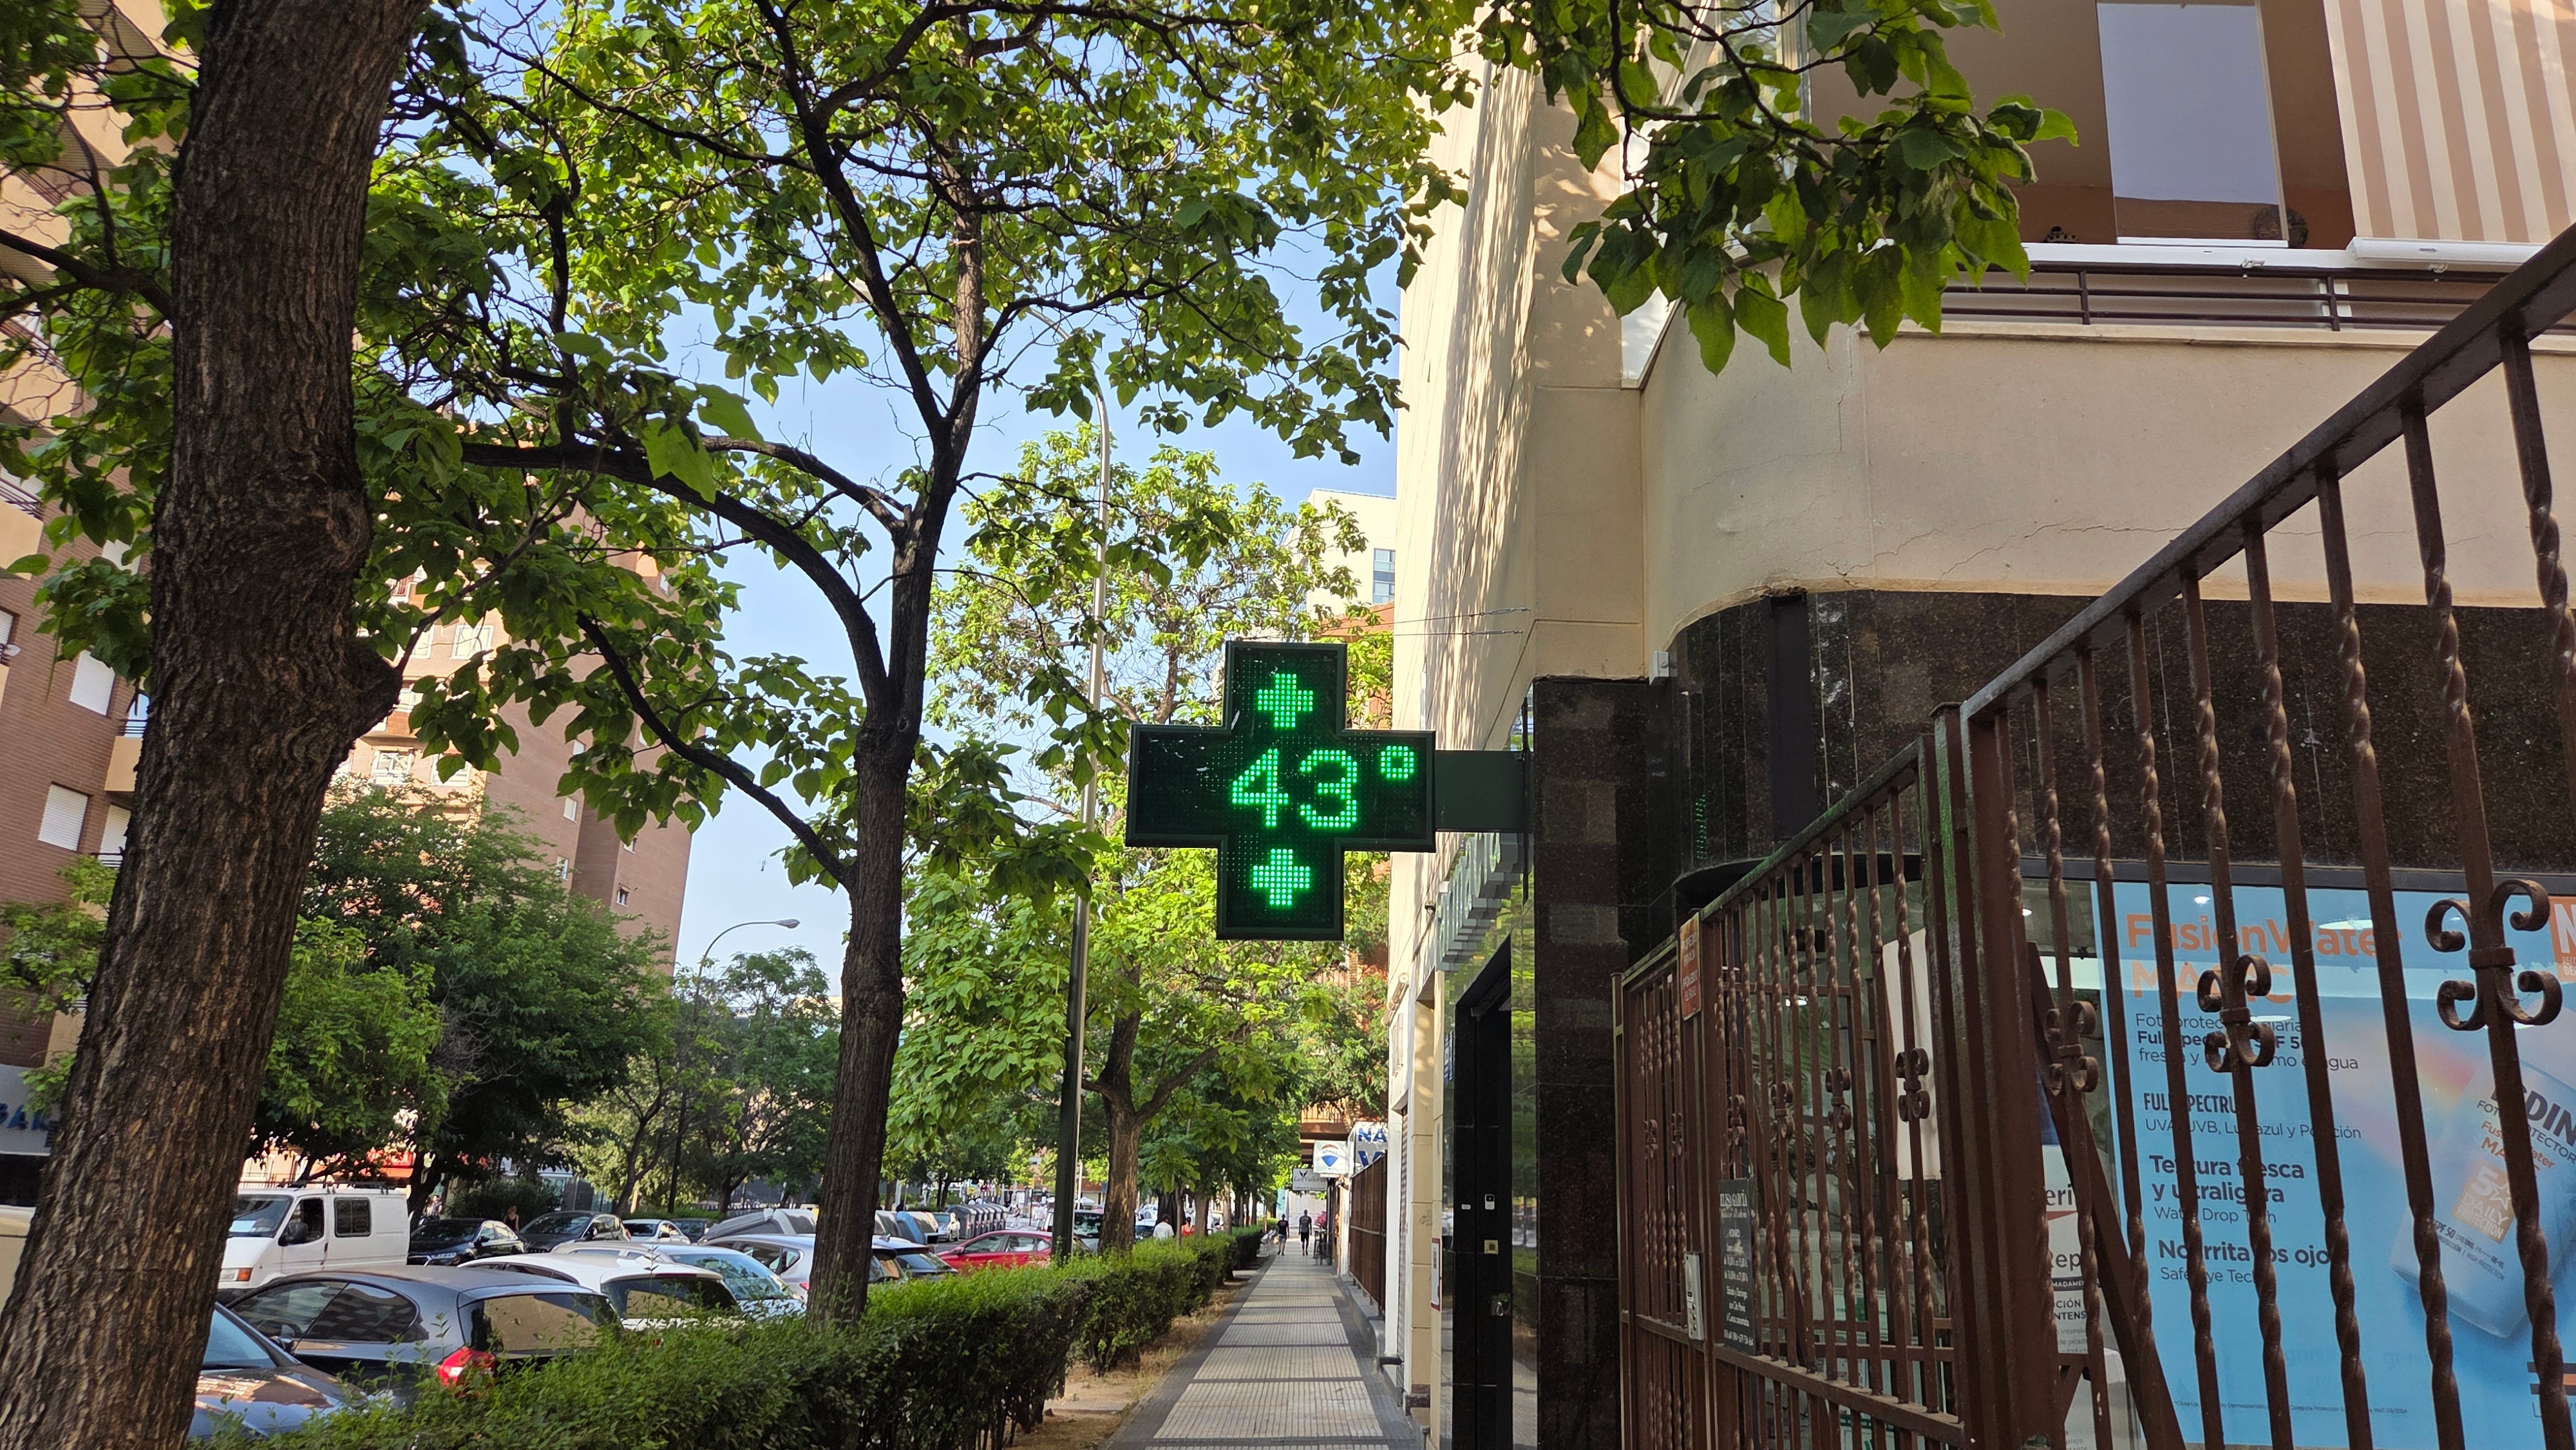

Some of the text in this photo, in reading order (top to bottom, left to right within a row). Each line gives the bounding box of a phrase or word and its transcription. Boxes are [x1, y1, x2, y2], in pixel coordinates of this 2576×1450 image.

[2286, 1126, 2296, 1138] y
[2149, 1154, 2231, 1176] Teura
[2152, 1183, 2165, 1202] y
[2202, 1207, 2239, 1224] Drop
[2295, 1245, 2331, 1268] ojo
